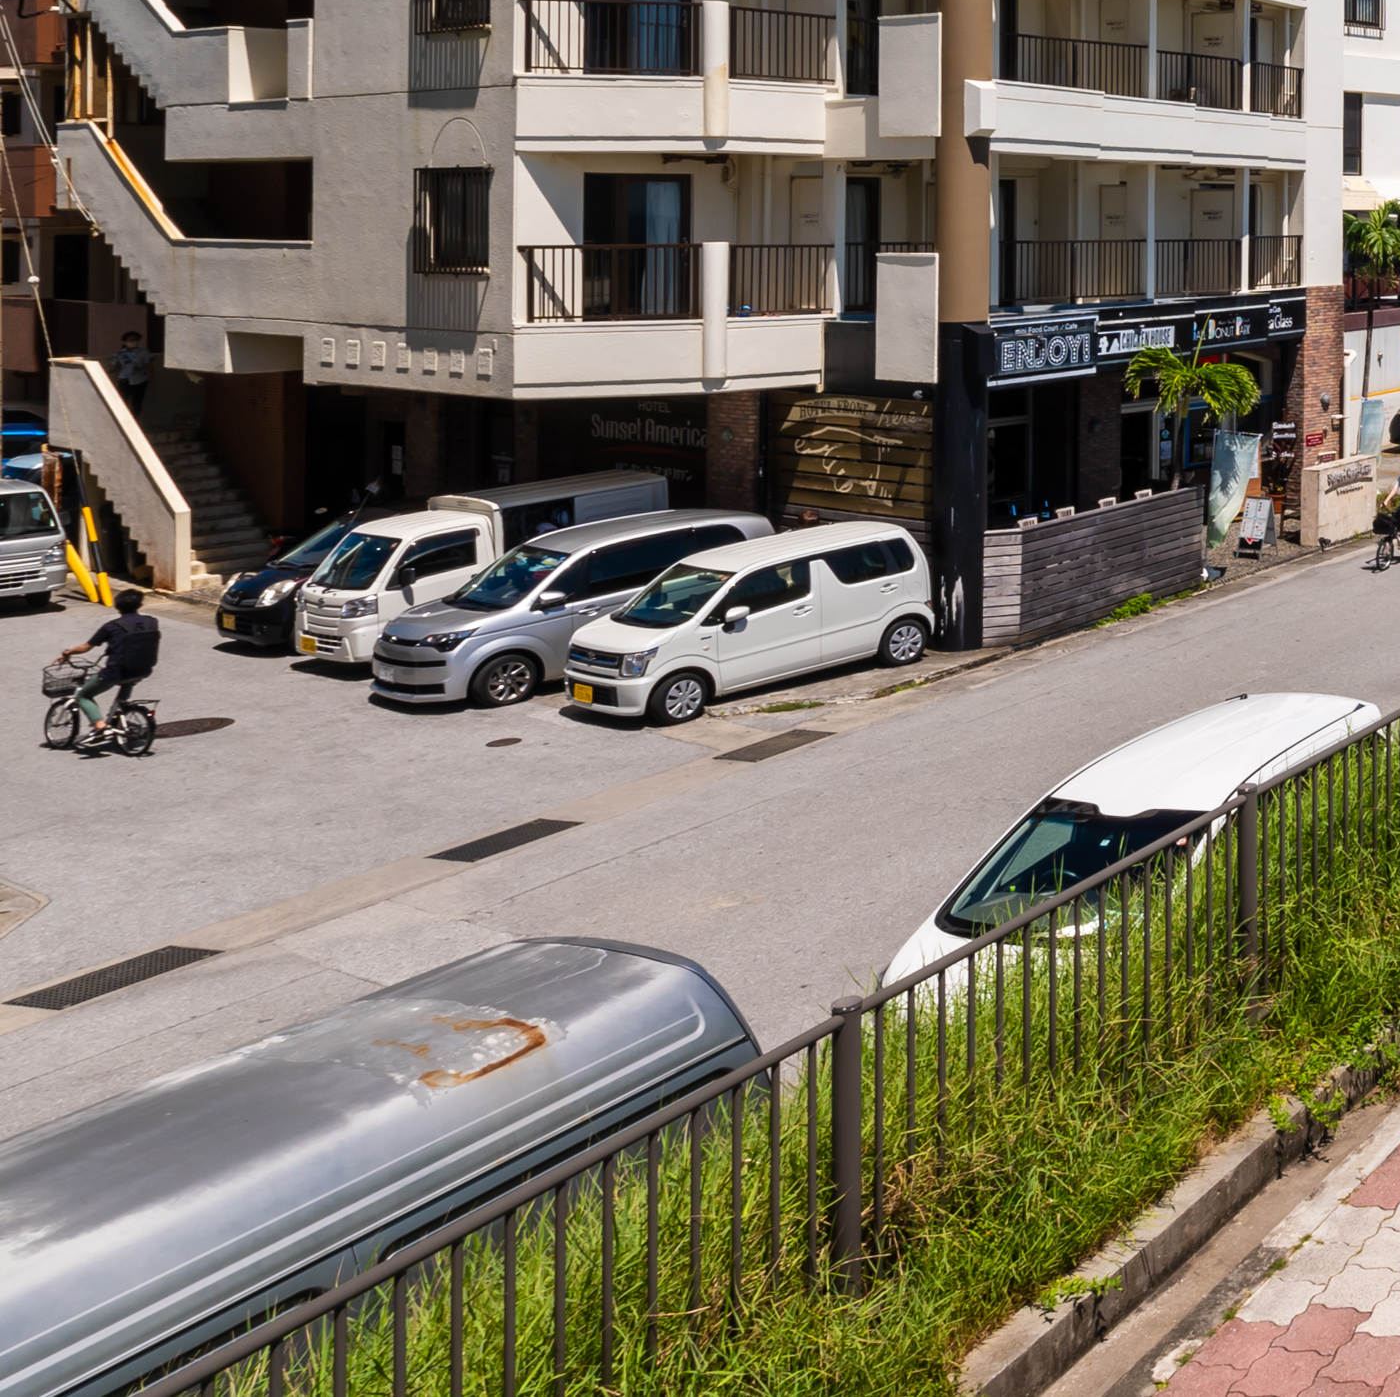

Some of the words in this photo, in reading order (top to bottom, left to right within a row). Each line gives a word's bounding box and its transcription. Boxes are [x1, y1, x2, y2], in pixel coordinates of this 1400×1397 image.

[1028, 325, 1043, 334] Food
[1043, 324, 1059, 333] Court
[1274, 312, 1293, 329] Glass
[1150, 328, 1172, 346] HOUSE
[1001, 334, 1090, 371] ENJOY!
[638, 400, 671, 414] HOTEL
[799, 399, 834, 419] HOTEL
[836, 399, 870, 417] FRONT
[591, 413, 643, 443] Sunset
